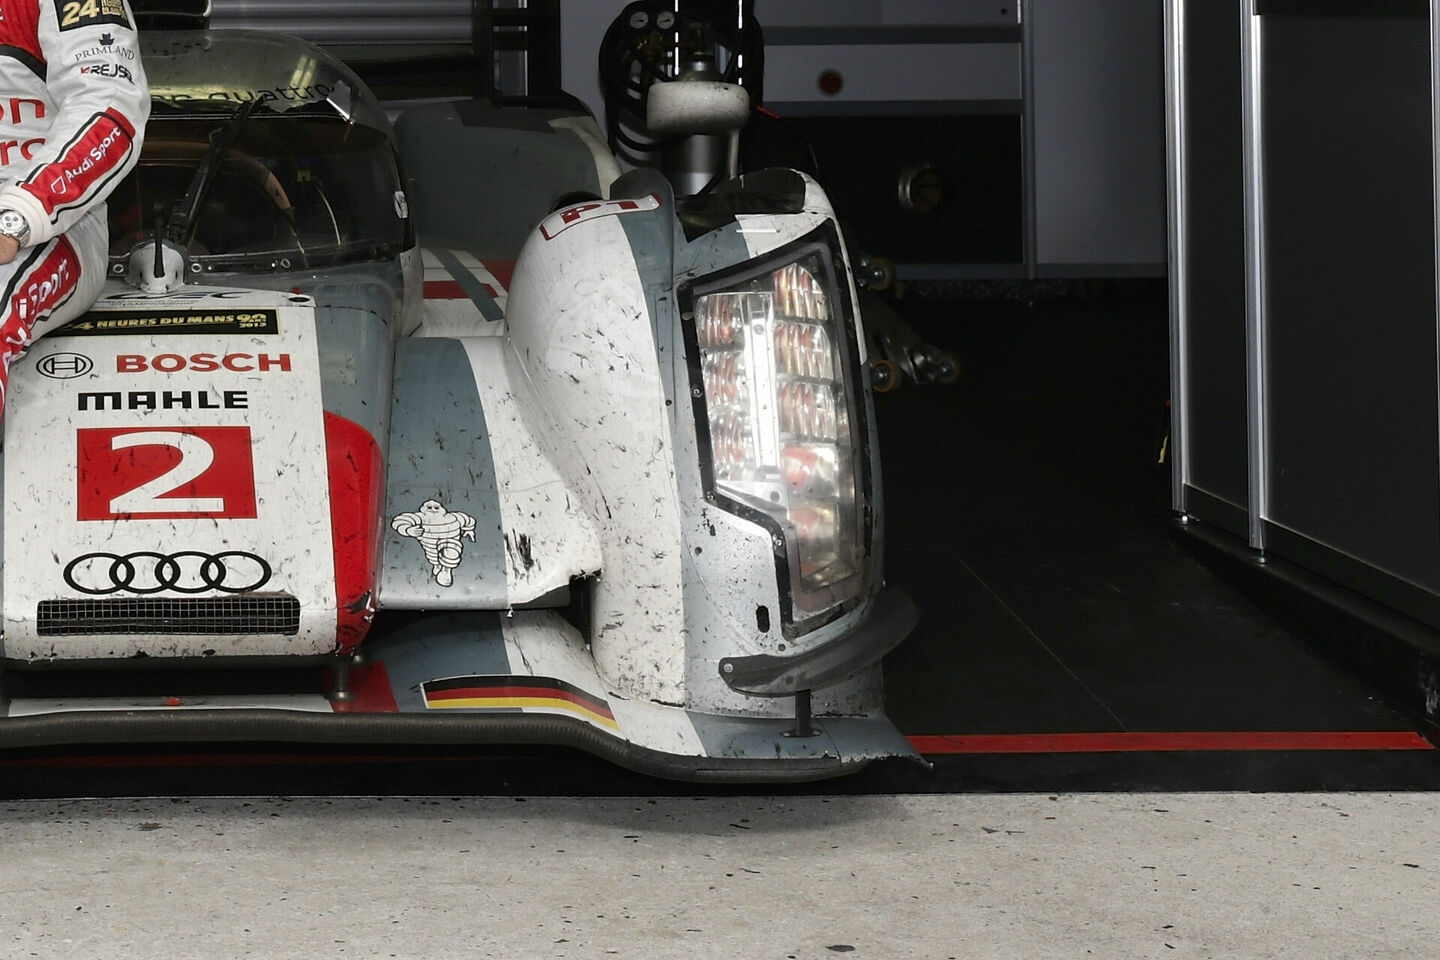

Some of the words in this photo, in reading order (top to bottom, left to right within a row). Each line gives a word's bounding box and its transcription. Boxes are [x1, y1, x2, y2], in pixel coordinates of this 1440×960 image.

[75, 46, 135, 61] PRIMLAND
[64, 158, 94, 184] Audi
[91, 126, 122, 161] Sport
[97, 316, 157, 329] HEURES
[160, 316, 185, 325] DU
[186, 314, 236, 324] MANS
[116, 353, 292, 373] BOSCH
[78, 391, 248, 411] MAHLE
[109, 431, 225, 514] 2
